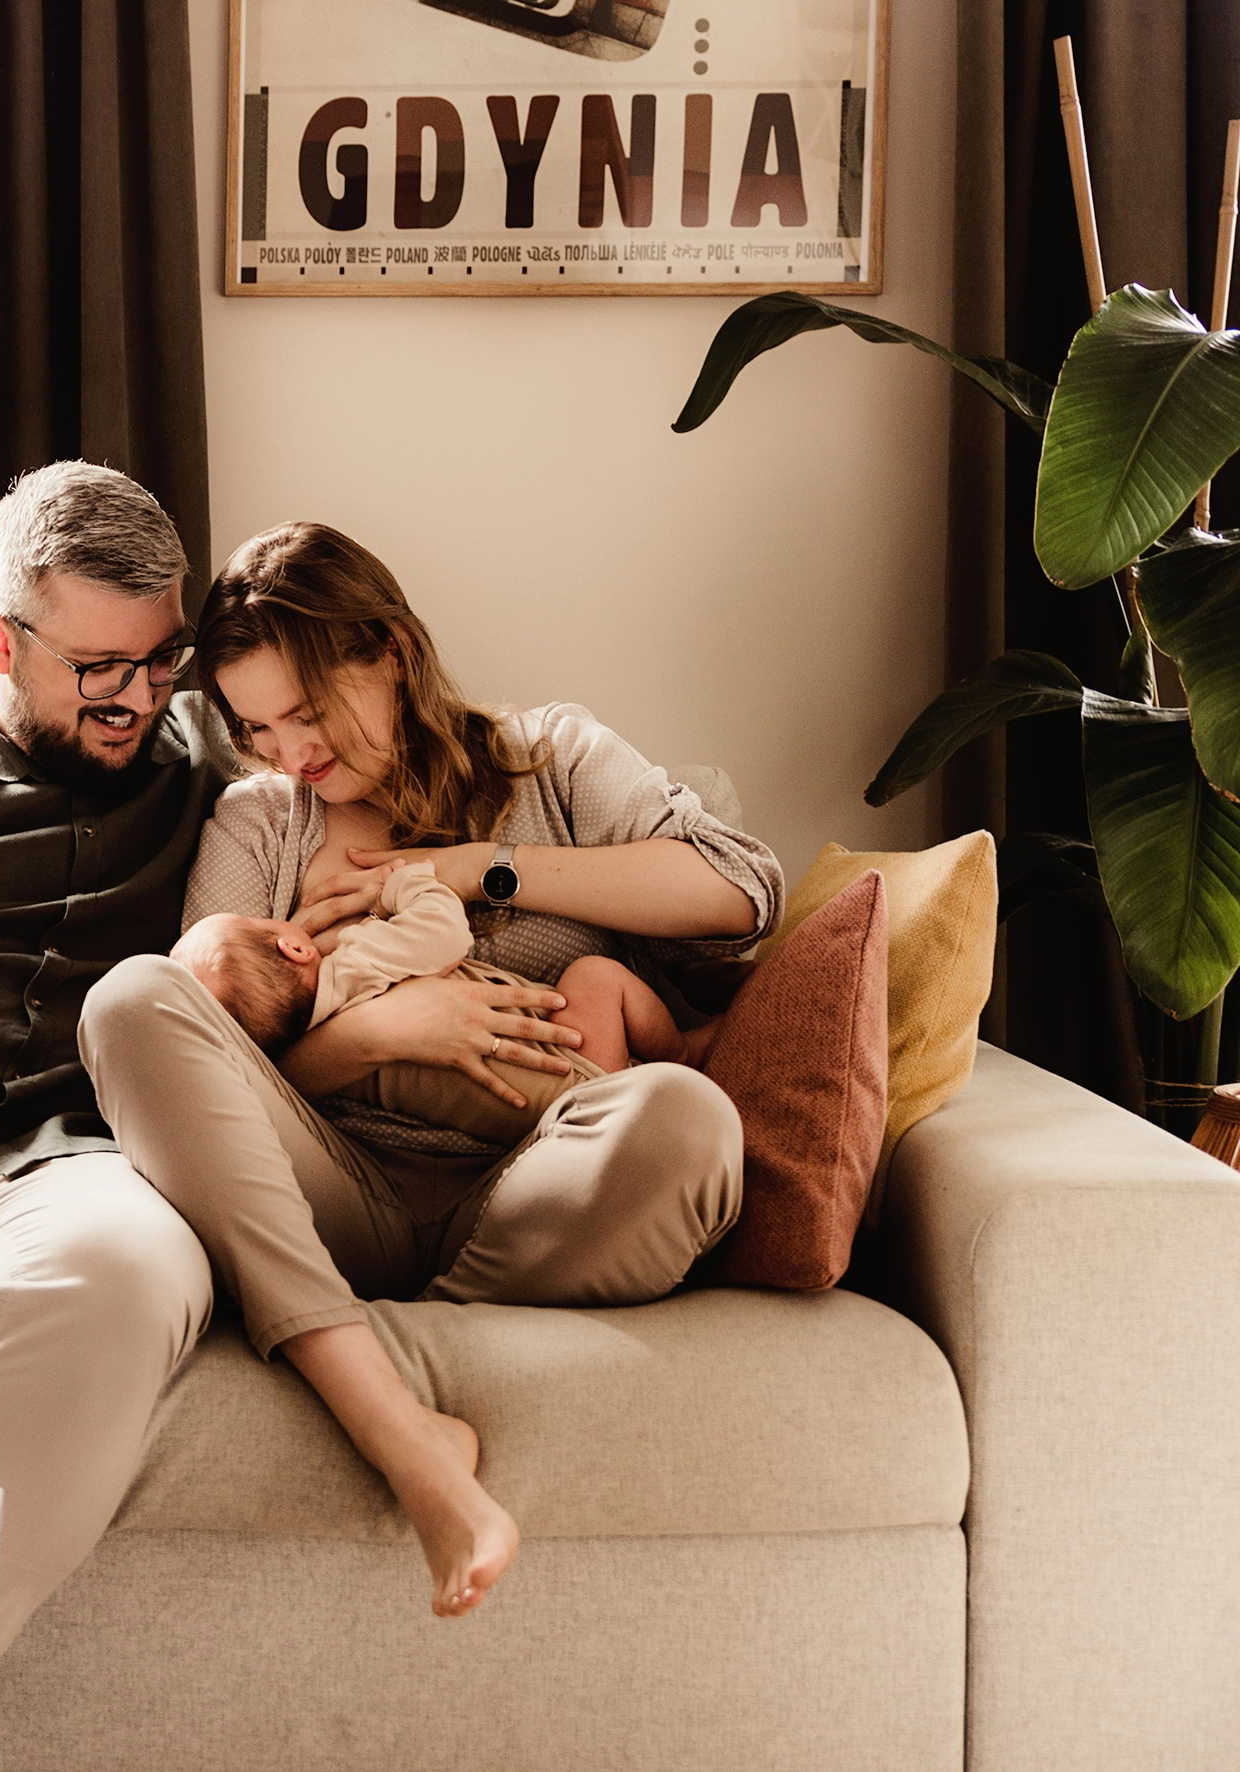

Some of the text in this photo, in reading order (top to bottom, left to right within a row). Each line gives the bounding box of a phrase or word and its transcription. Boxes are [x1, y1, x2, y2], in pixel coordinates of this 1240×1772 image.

[298, 92, 808, 231] GDYNIA
[259, 247, 300, 264] POLSKA
[346, 247, 382, 264] 폴란드
[386, 247, 429, 264] POLAND
[472, 246, 522, 262] POLOGNE
[564, 244, 618, 261] ПОЛЬША
[707, 244, 735, 261] POLE
[796, 242, 844, 259] POLONIA
